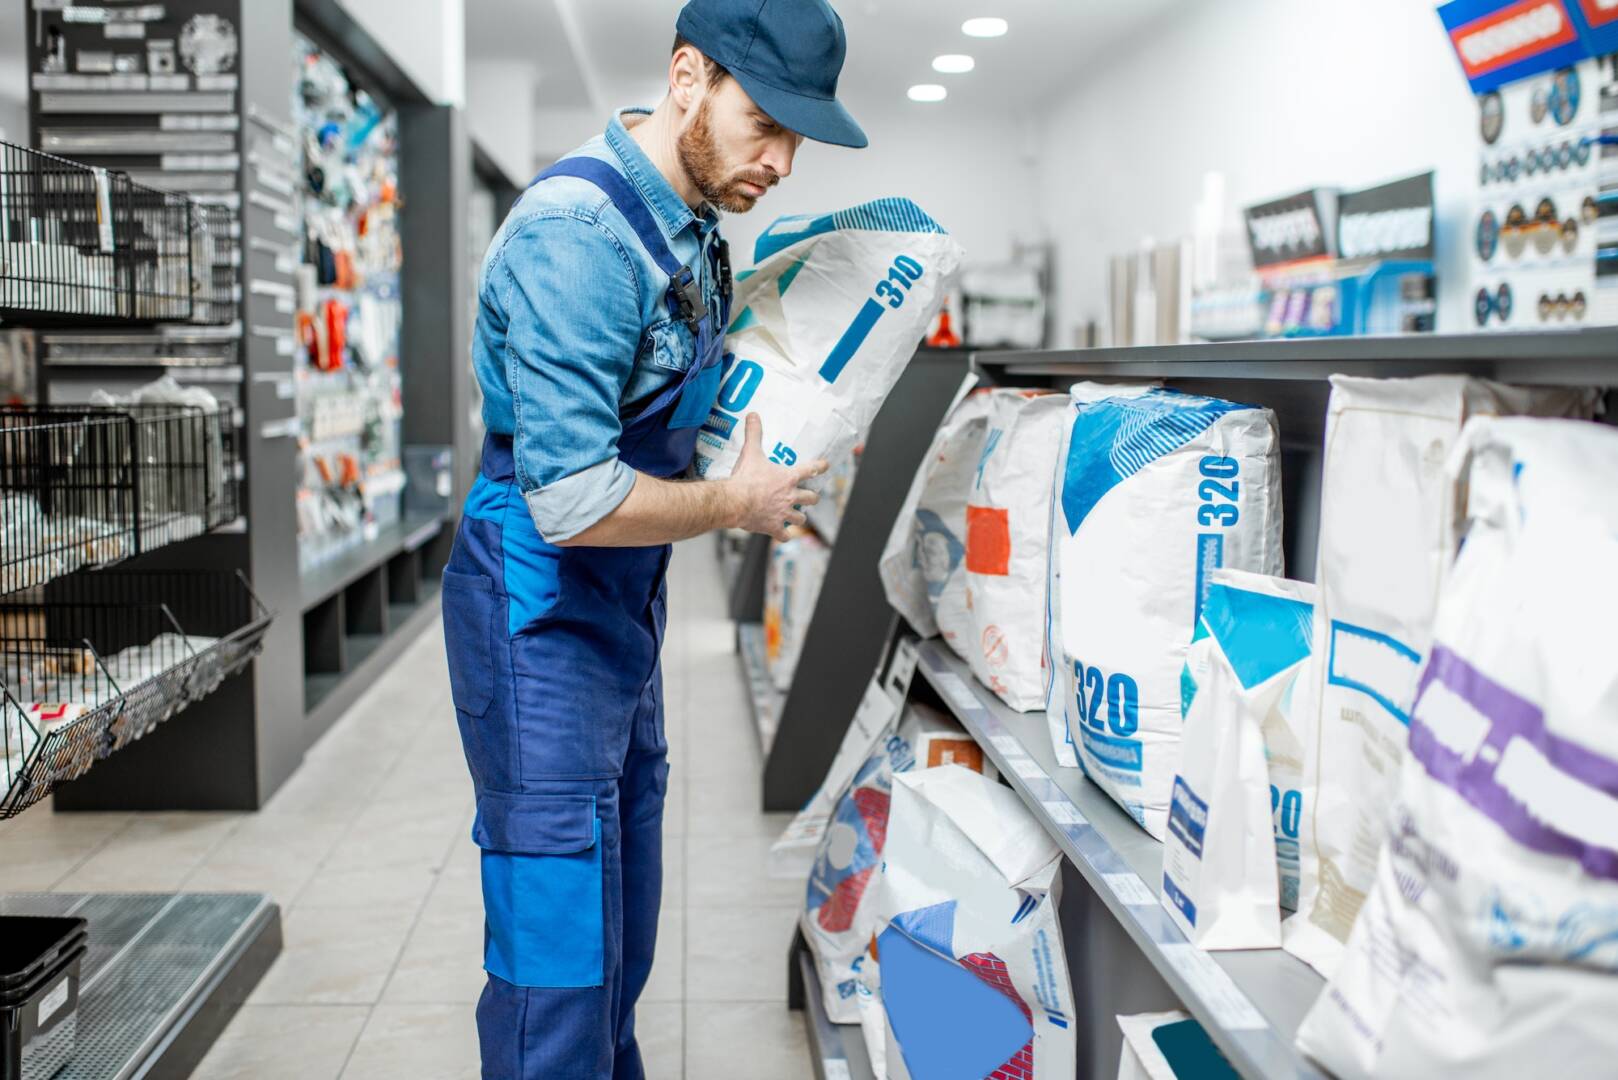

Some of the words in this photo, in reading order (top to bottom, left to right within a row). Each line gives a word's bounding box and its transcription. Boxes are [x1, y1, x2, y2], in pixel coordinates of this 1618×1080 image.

[875, 254, 924, 309] 310
[718, 354, 764, 412] 0
[1197, 455, 1240, 527] 320
[1074, 659, 1138, 737] 320
